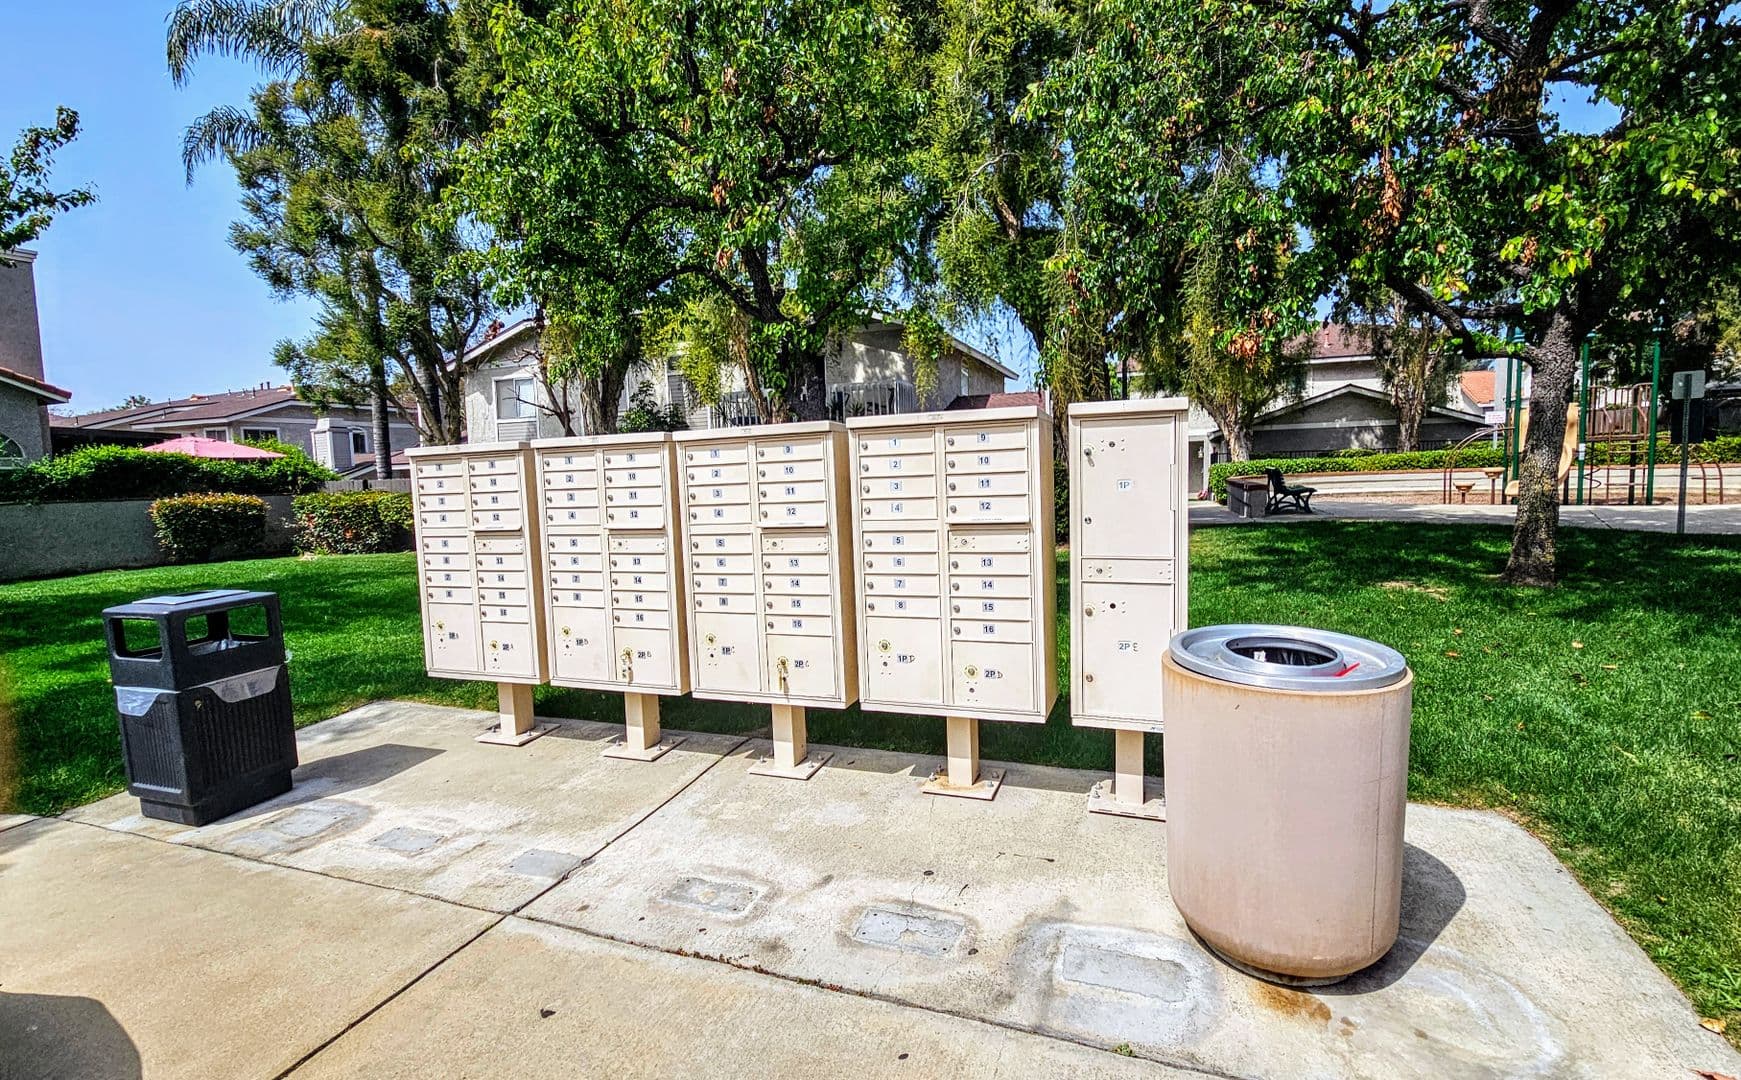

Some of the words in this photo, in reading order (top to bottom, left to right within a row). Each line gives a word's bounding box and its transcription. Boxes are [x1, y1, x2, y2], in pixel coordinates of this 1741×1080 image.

[979, 456, 989, 464] 10
[980, 479, 990, 487] 11
[981, 502, 991, 510] 12
[982, 558, 992, 566] 13
[983, 581, 993, 589] 14
[984, 603, 994, 611] 15
[984, 625, 994, 633] 16
[722, 647, 731, 655] 1P
[898, 655, 907, 663] 1P
[794, 660, 803, 668] 2P
